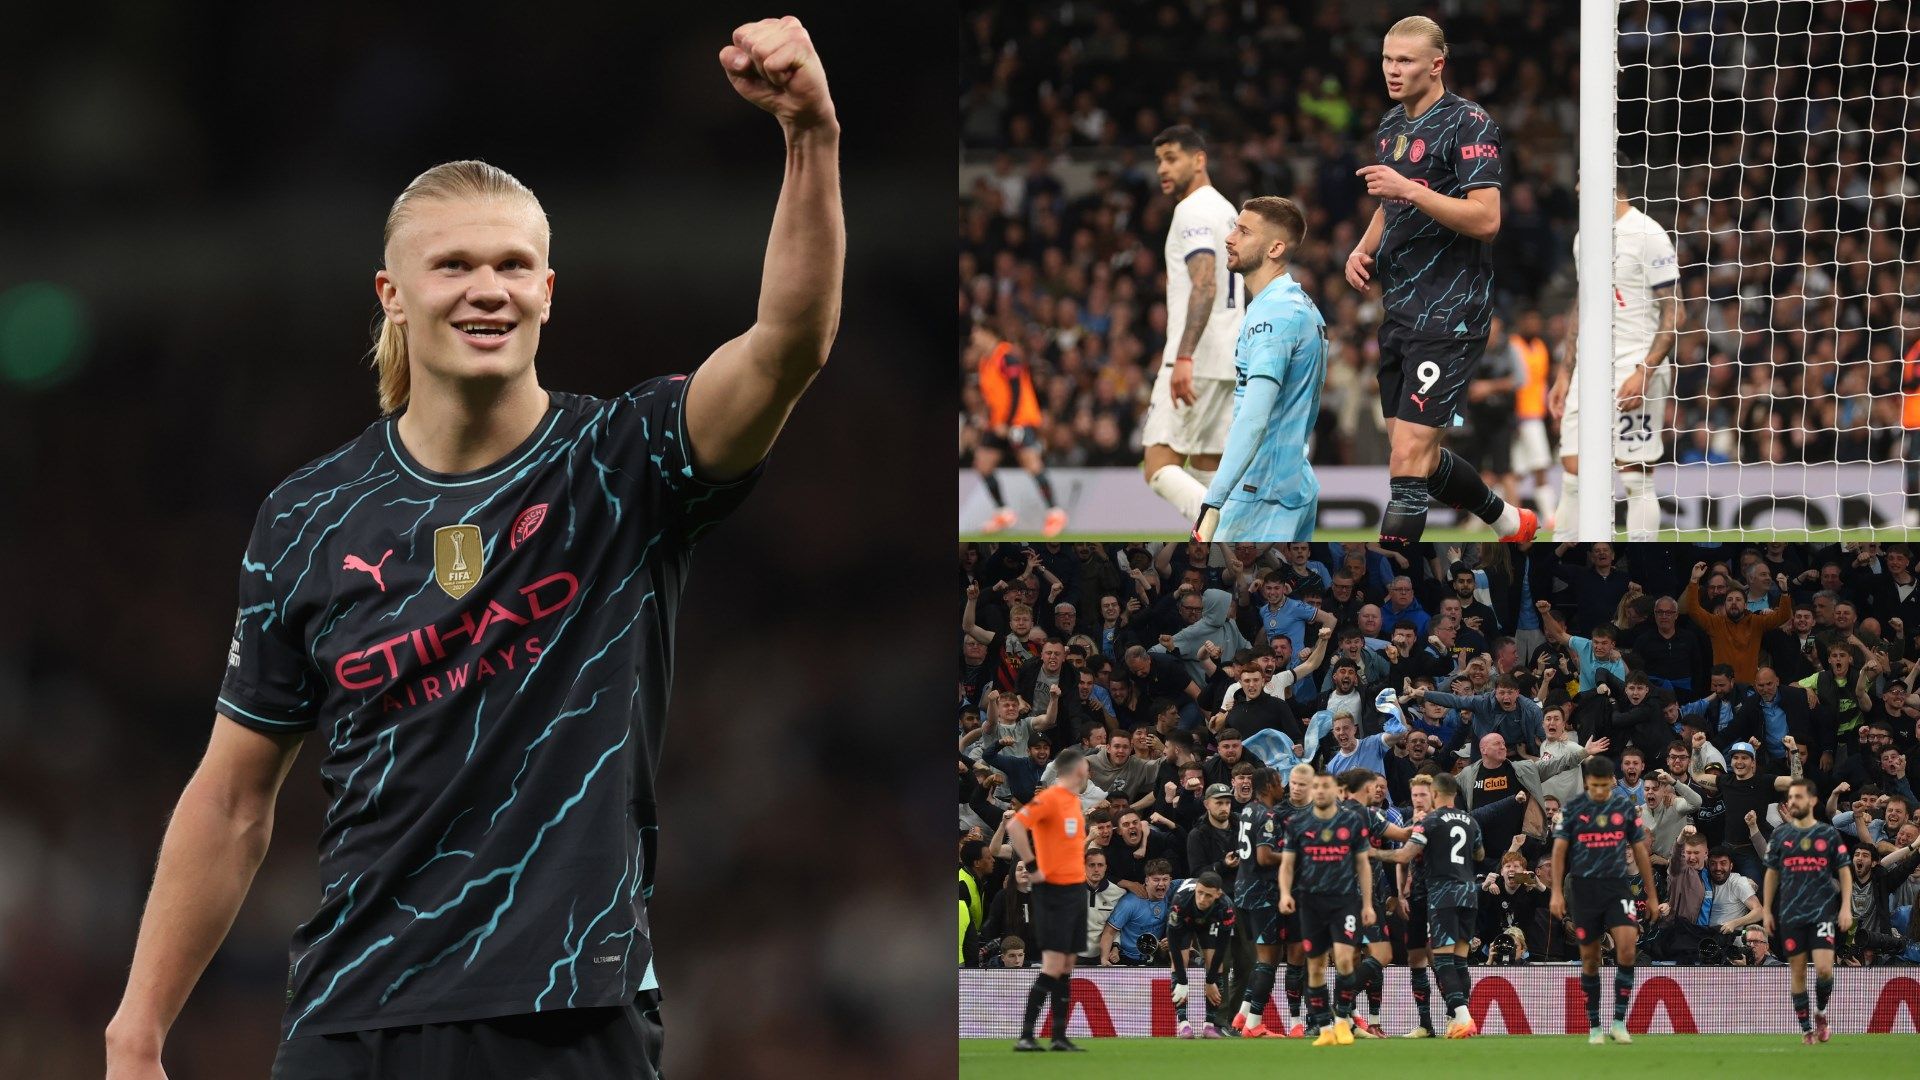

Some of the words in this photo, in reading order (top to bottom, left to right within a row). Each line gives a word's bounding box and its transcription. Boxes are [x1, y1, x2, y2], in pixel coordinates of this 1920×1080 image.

[1416, 360, 1441, 395] 9
[1619, 414, 1653, 442] 23
[448, 571, 471, 580] FIFA
[335, 571, 579, 690] ETIHAD
[382, 637, 543, 712] AIRWAYS
[1485, 778, 1506, 789] club
[1440, 813, 1471, 826] WALKER
[1449, 825, 1467, 865] 2
[1578, 831, 1625, 842] ETIHAD
[1783, 856, 1828, 867] ETIHAD
[1344, 914, 1356, 932] 8
[1816, 921, 1836, 938] 20
